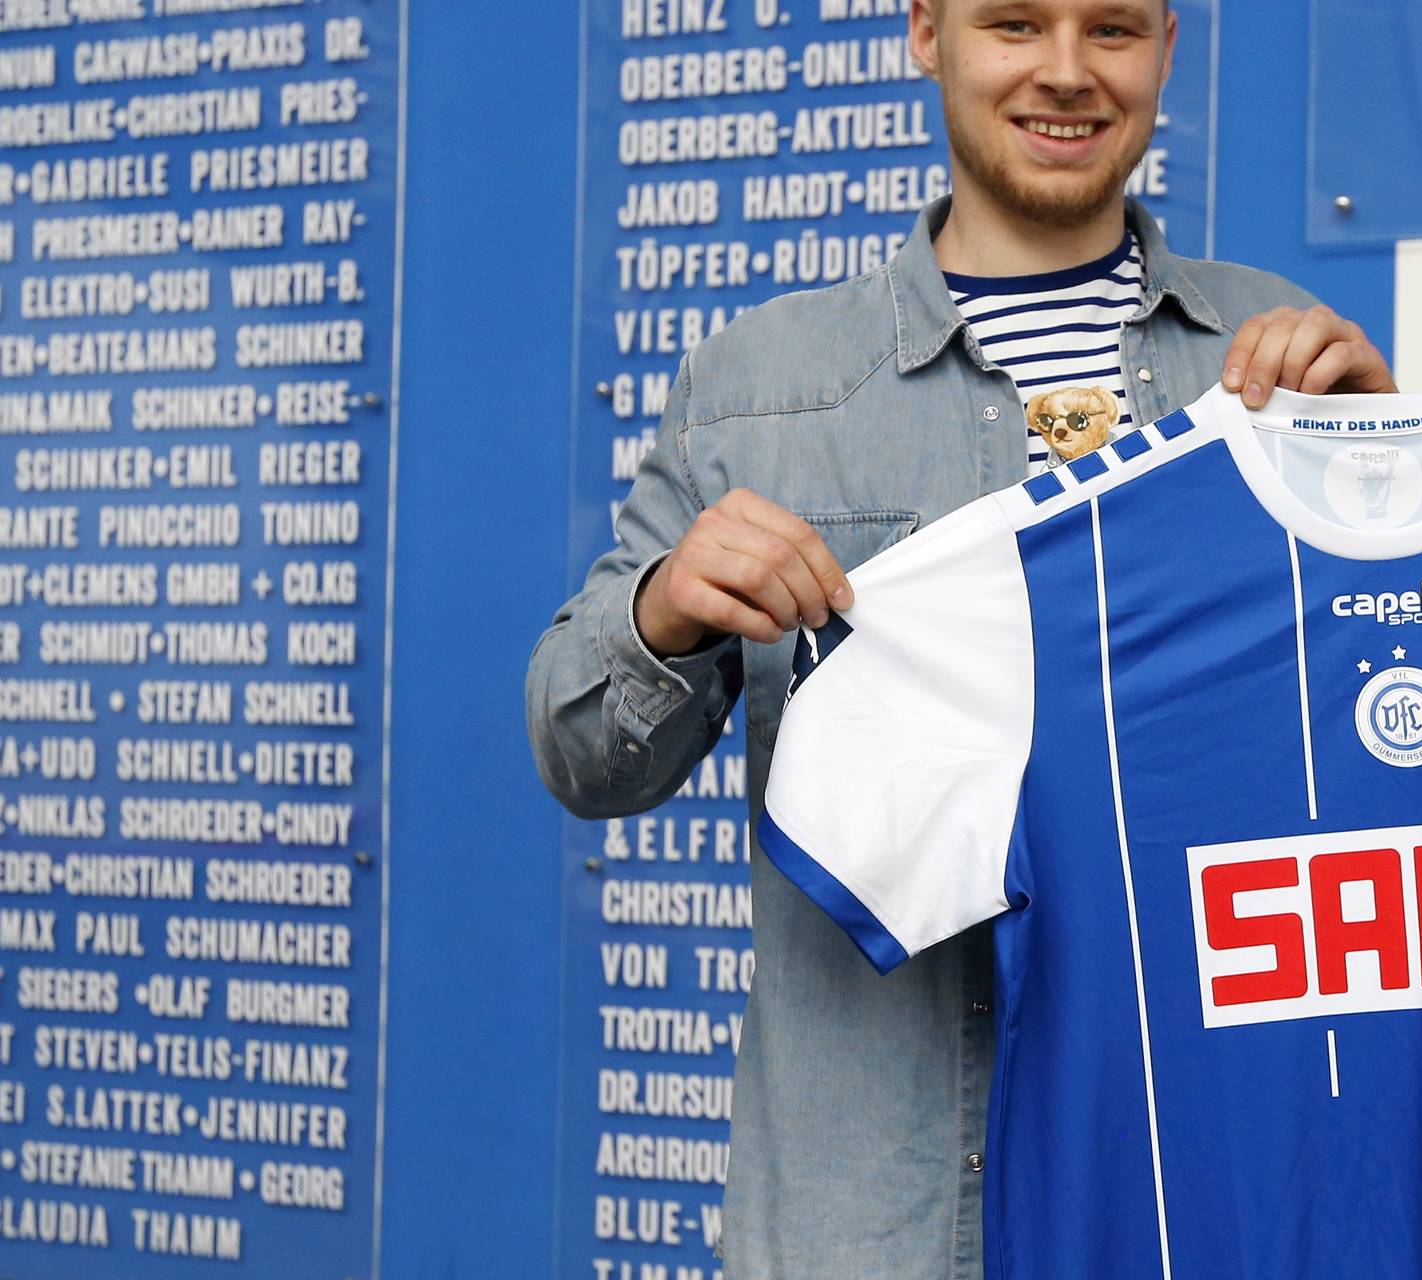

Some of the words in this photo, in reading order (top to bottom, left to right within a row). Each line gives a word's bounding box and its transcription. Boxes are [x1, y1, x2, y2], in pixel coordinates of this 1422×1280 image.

[74, 34, 200, 83] CARWASH
[210, 22, 304, 70] PRAXIS
[325, 17, 367, 60] DR.
[126, 89, 260, 137] CHRISTIAN
[281, 78, 365, 124] PRIES-
[619, 98, 930, 164] OBERBERG-AKTUELL
[30, 154, 166, 203] GABRIELE
[191, 138, 368, 189] PRIESMEIER
[618, 179, 718, 227] JAKOB
[743, 171, 849, 220] HARDT
[32, 212, 181, 259] PRIESMEIER
[190, 205, 283, 249] RAINER
[303, 201, 363, 242] RAY-
[617, 238, 749, 289] TÖPFER
[20, 272, 136, 319] ELEKTRO
[147, 269, 210, 312] SUSI
[235, 320, 363, 367] SCHINKER
[131, 384, 257, 430] SCHINKER
[1293, 418, 1342, 431] HEIMAT
[1348, 420, 1377, 431] DES
[15, 446, 153, 491] SCHINKER
[169, 445, 237, 488] EMIL
[259, 441, 360, 484] RIEGER
[99, 503, 240, 547] PINOCCHIO
[260, 501, 359, 544] TONINO
[166, 563, 240, 605] GMBH
[40, 622, 153, 663] SCHMIDT
[164, 621, 267, 664] THOMAS
[287, 622, 355, 664] KOCH
[138, 681, 231, 722] STEFAN
[244, 682, 353, 724] SCHNELL
[117, 739, 236, 782] SCHNELL
[255, 742, 353, 784] DIETER
[17, 796, 105, 837] NIKLAS
[120, 798, 264, 842] SCHROEDER
[274, 802, 352, 844] CINDY
[63, 854, 193, 897] CHRISTIAN
[206, 860, 351, 905] SCHROEDER
[76, 913, 142, 955] PAUL
[166, 917, 350, 965] SCHUMACHER
[601, 943, 667, 987] VON
[19, 968, 118, 1011] SIEGERS
[146, 975, 209, 1016] OLAF
[227, 980, 349, 1026] BURGMER
[600, 1006, 712, 1054] TROTHA
[35, 1027, 137, 1071] STEVEN
[155, 1035, 347, 1087] TELIS-FINANZ
[48, 1086, 180, 1132] S.LATTEK
[201, 1099, 346, 1147] JENNIFER
[21, 1142, 134, 1189] STEFANIE
[142, 1152, 233, 1196] THAMM
[261, 1162, 343, 1208] GEORG
[133, 1210, 240, 1257] THAMM
